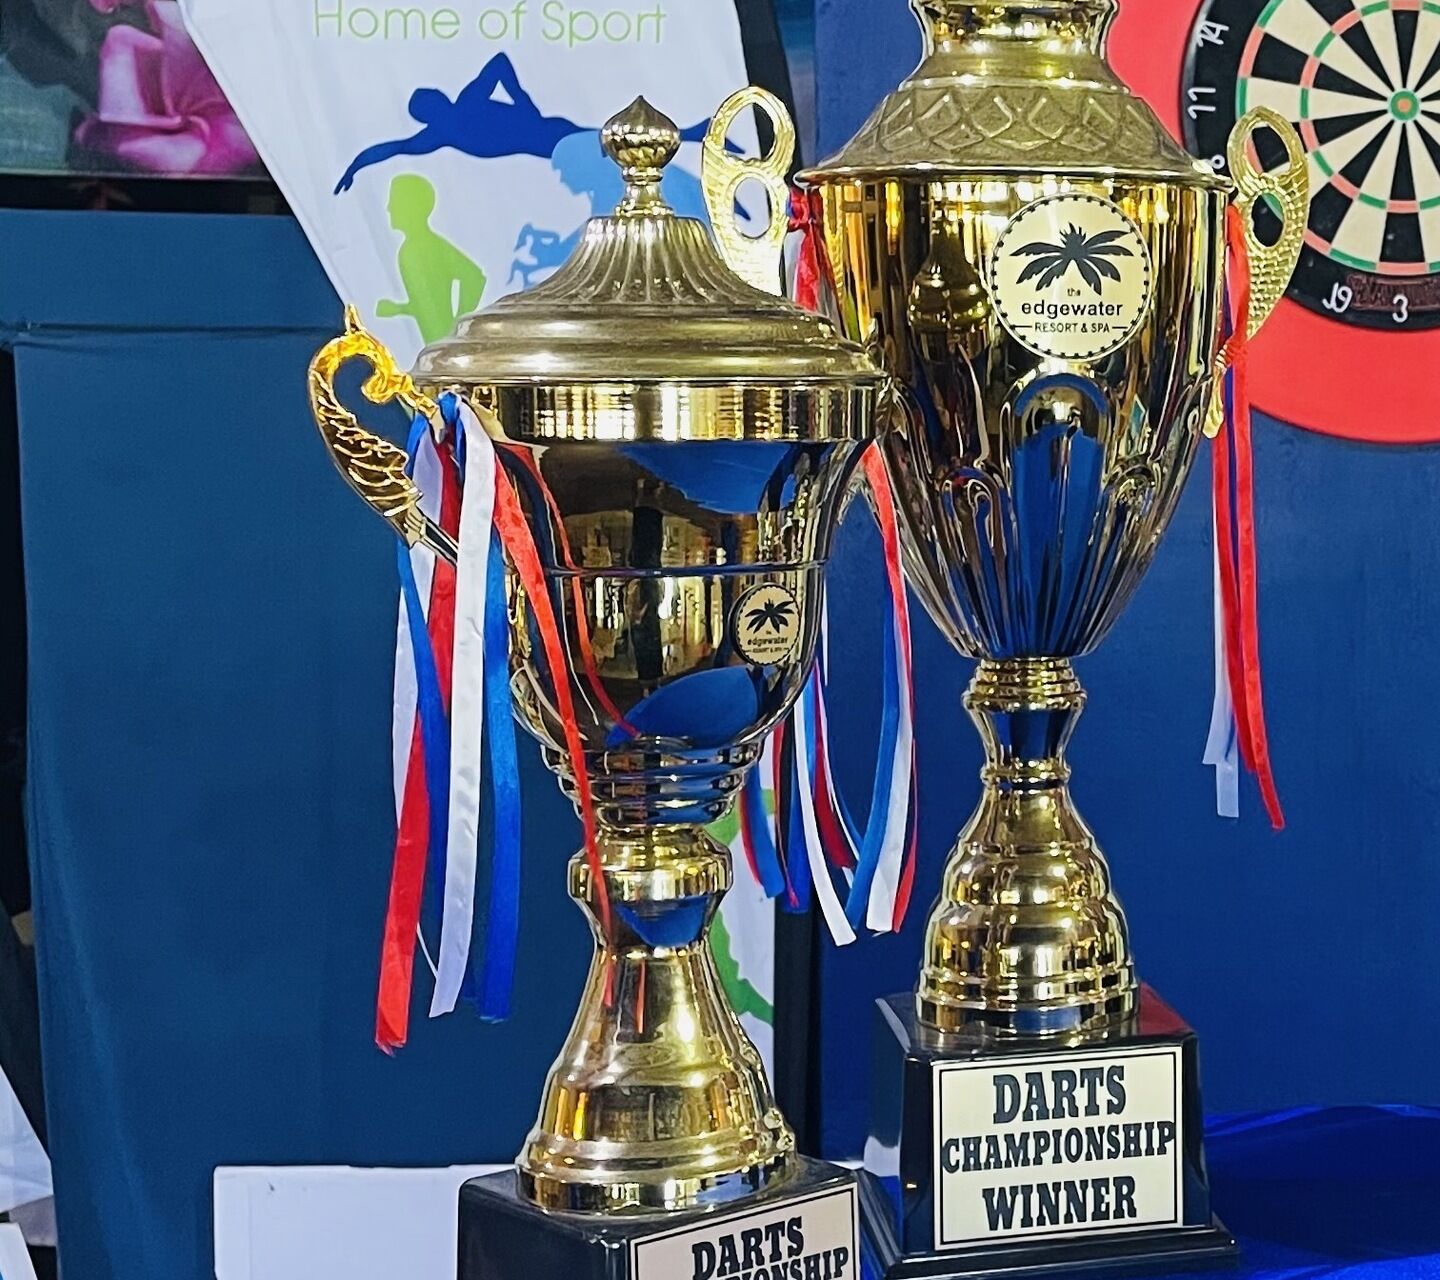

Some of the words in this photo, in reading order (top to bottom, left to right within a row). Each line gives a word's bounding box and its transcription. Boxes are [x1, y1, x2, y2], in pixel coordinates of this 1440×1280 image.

[479, 0, 527, 40] of
[542, 0, 667, 48] Sport
[1021, 300, 1123, 319] edgewater
[1067, 288, 1081, 297] the
[1392, 293, 1409, 323] 3
[1034, 322, 1077, 333] RESORT
[1080, 322, 1088, 333] &
[1090, 322, 1110, 333] SPA
[993, 1065, 1126, 1124] DARTS
[942, 1120, 1175, 1174] CHAMPIONSHIP
[982, 1175, 1137, 1231] WINNER
